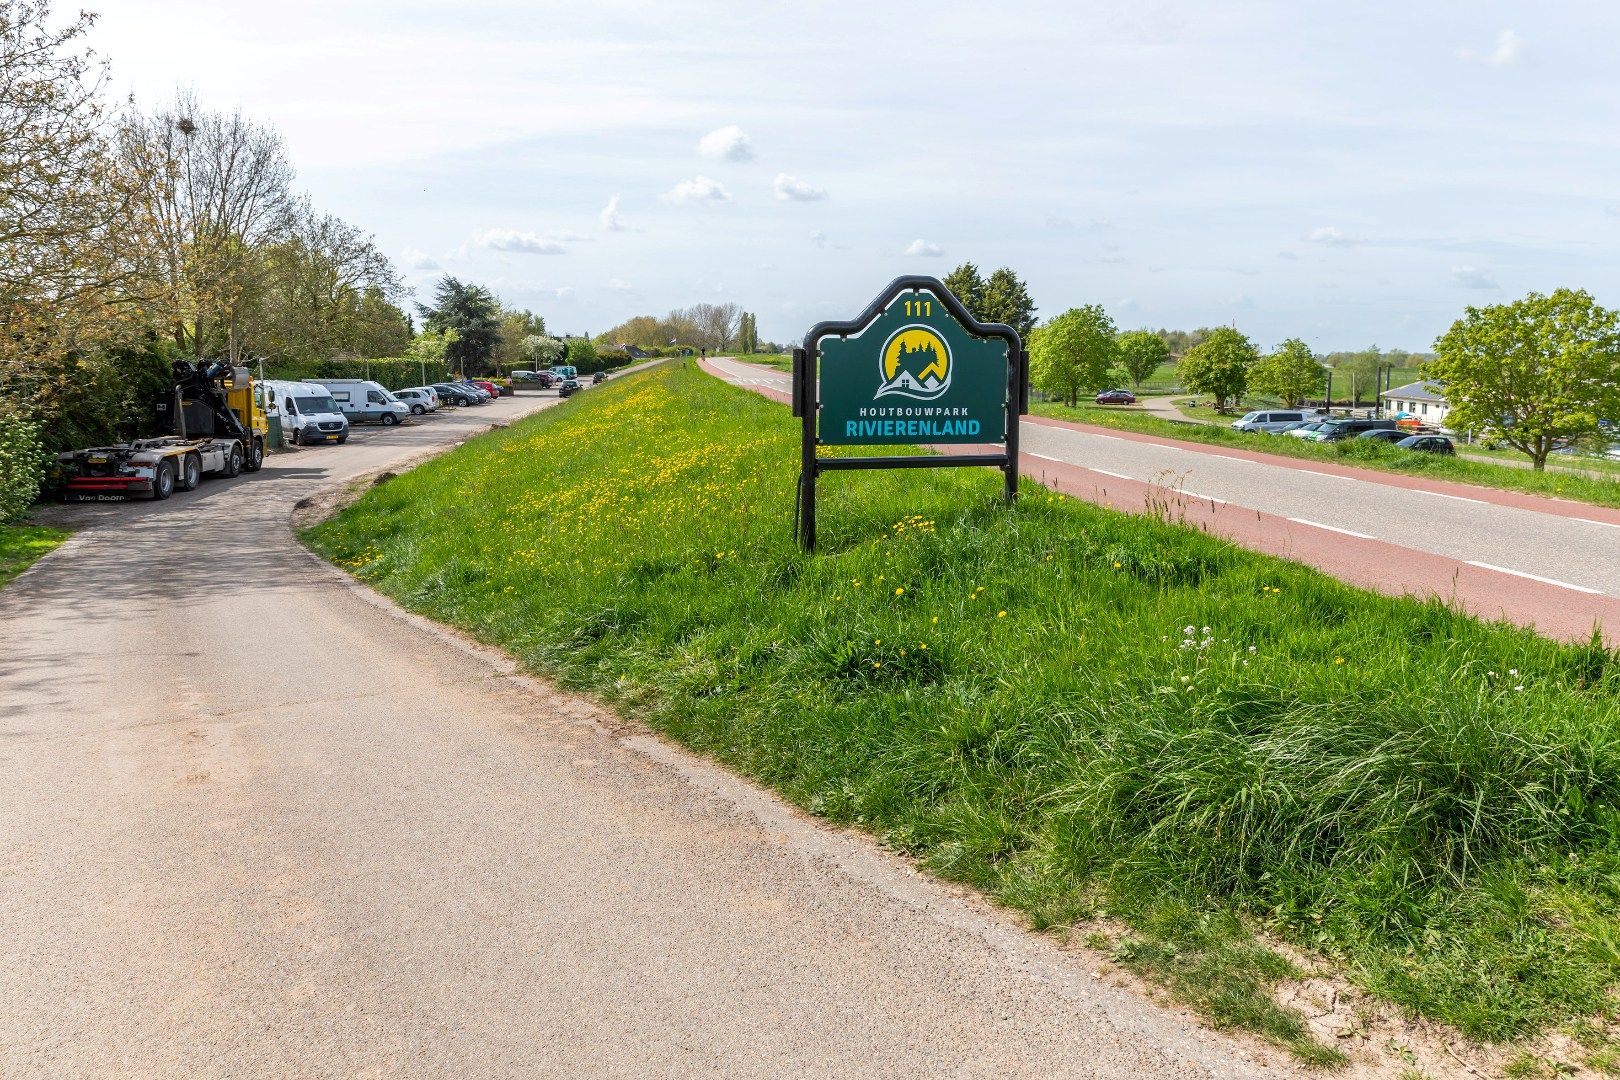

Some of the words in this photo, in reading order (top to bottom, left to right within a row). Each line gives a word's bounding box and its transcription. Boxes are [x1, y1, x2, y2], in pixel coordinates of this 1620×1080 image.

[904, 301, 931, 316] 111
[860, 408, 968, 416] HOUTBOUWPARK
[846, 419, 981, 437] RIVIERENLAND
